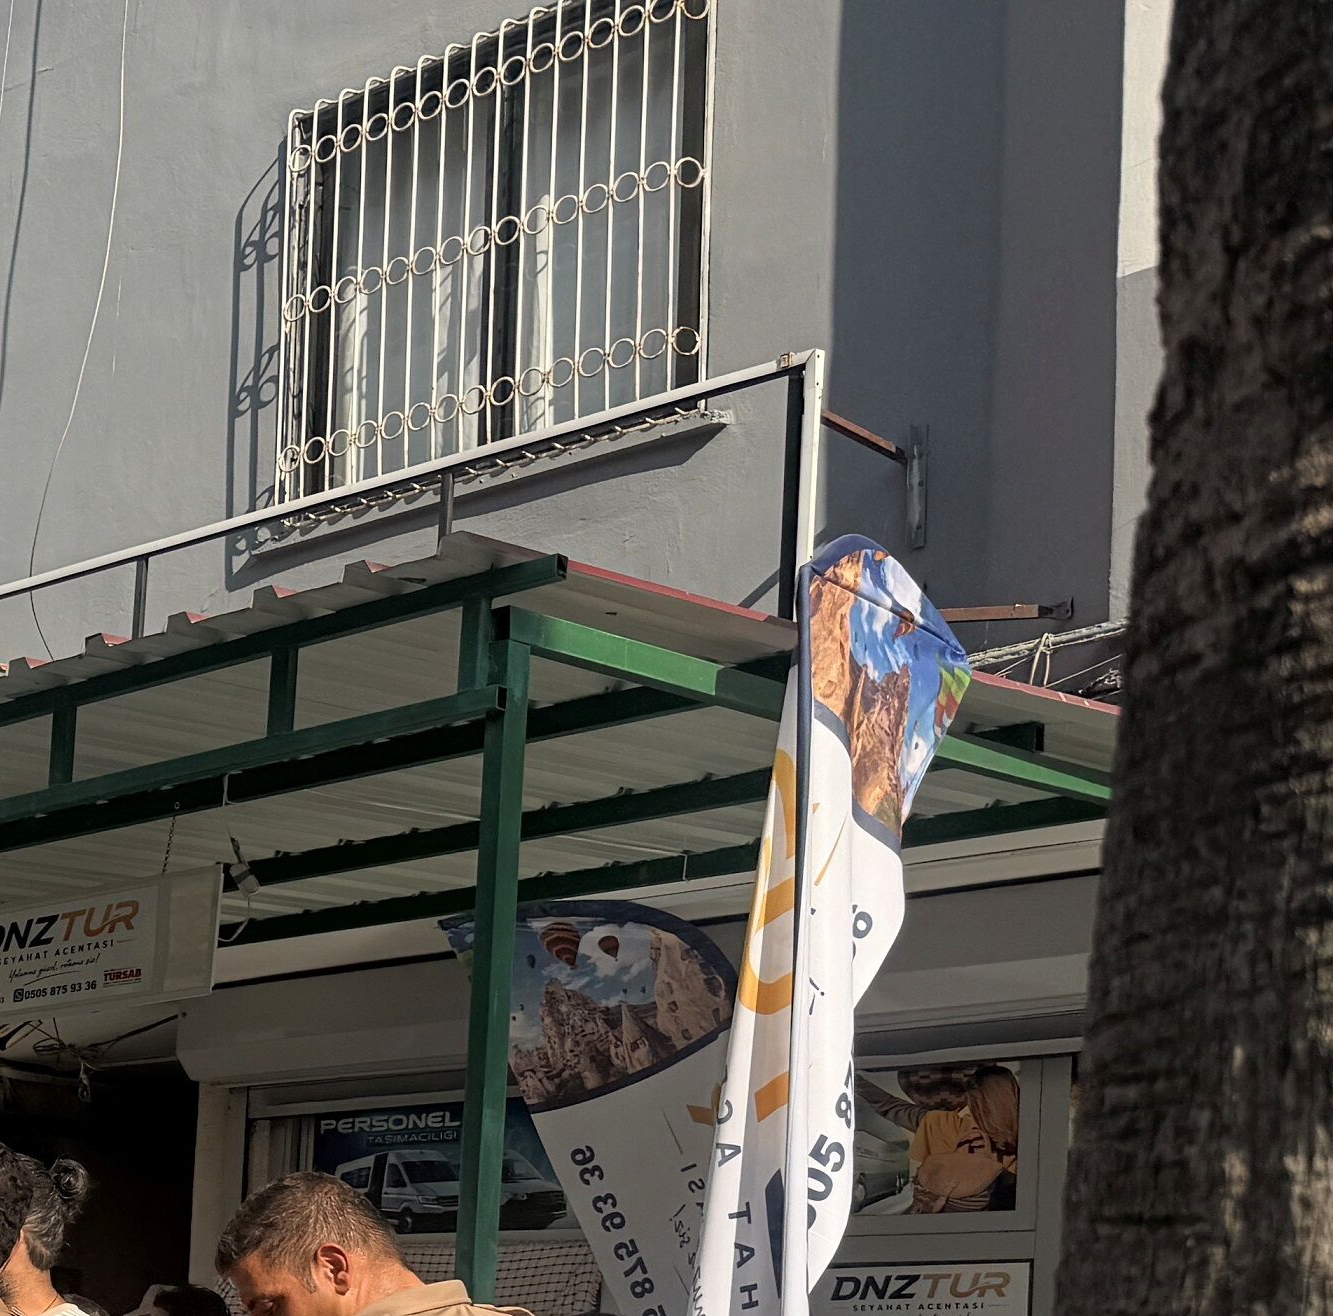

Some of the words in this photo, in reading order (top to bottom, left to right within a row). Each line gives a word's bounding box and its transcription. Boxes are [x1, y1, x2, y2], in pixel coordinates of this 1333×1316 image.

[54, 938, 115, 957] ACENTASI
[24, 987, 48, 1001] 0505
[49, 984, 69, 997] 875
[70, 982, 83, 994] 93
[84, 980, 97, 991] 36
[320, 1110, 462, 1135] PERSONEL
[830, 1271, 1012, 1301] DNZTUR
[852, 1304, 910, 1313] SEYAHAT
